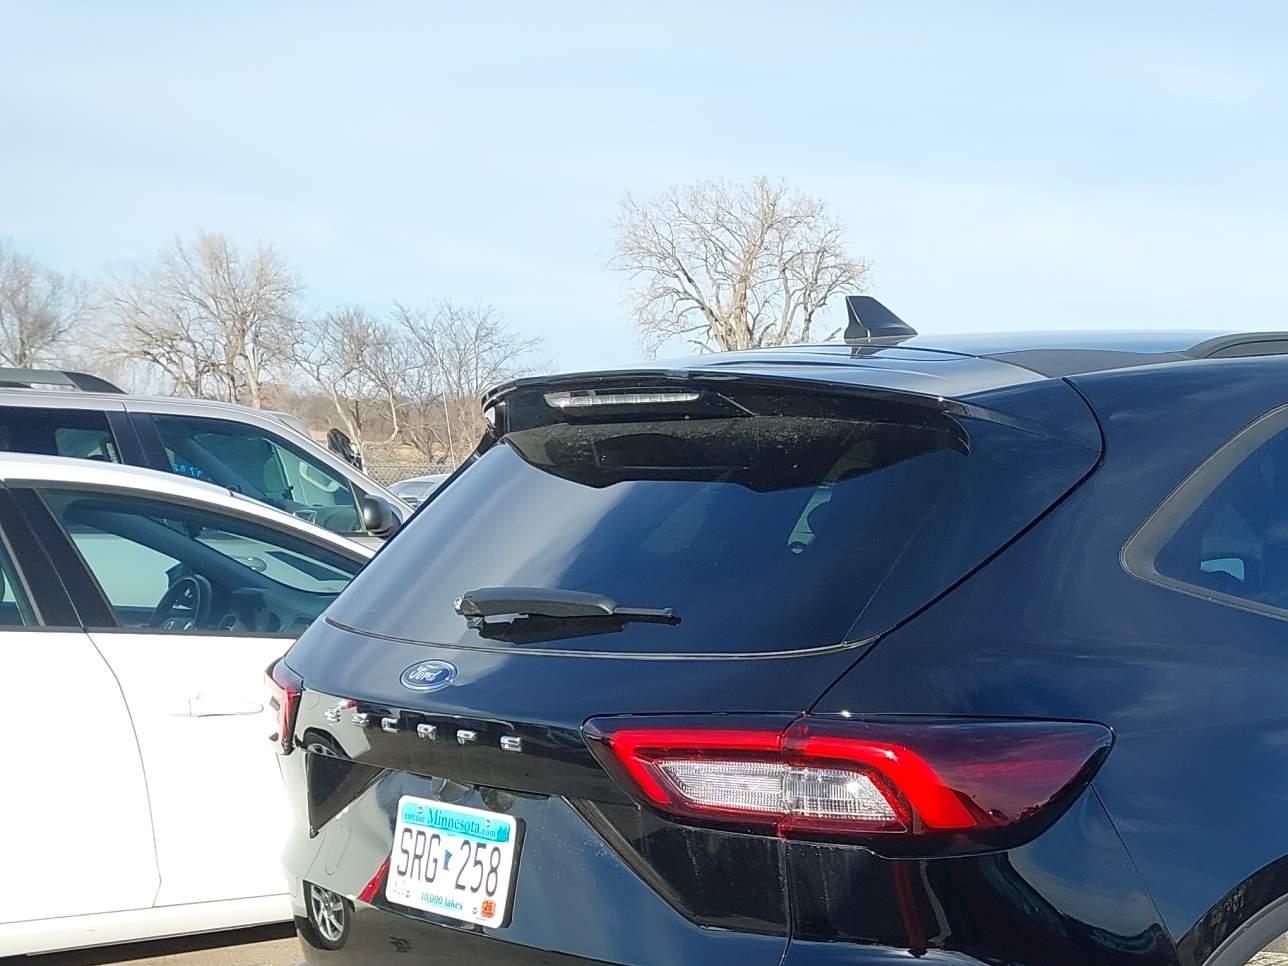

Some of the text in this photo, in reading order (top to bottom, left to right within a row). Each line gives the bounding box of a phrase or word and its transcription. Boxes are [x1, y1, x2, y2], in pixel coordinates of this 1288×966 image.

[409, 664, 443, 683] Ford
[324, 707, 522, 753] ESCAPE
[397, 827, 501, 897] SRG 258
[420, 891, 464, 911] 10,000 lakes
